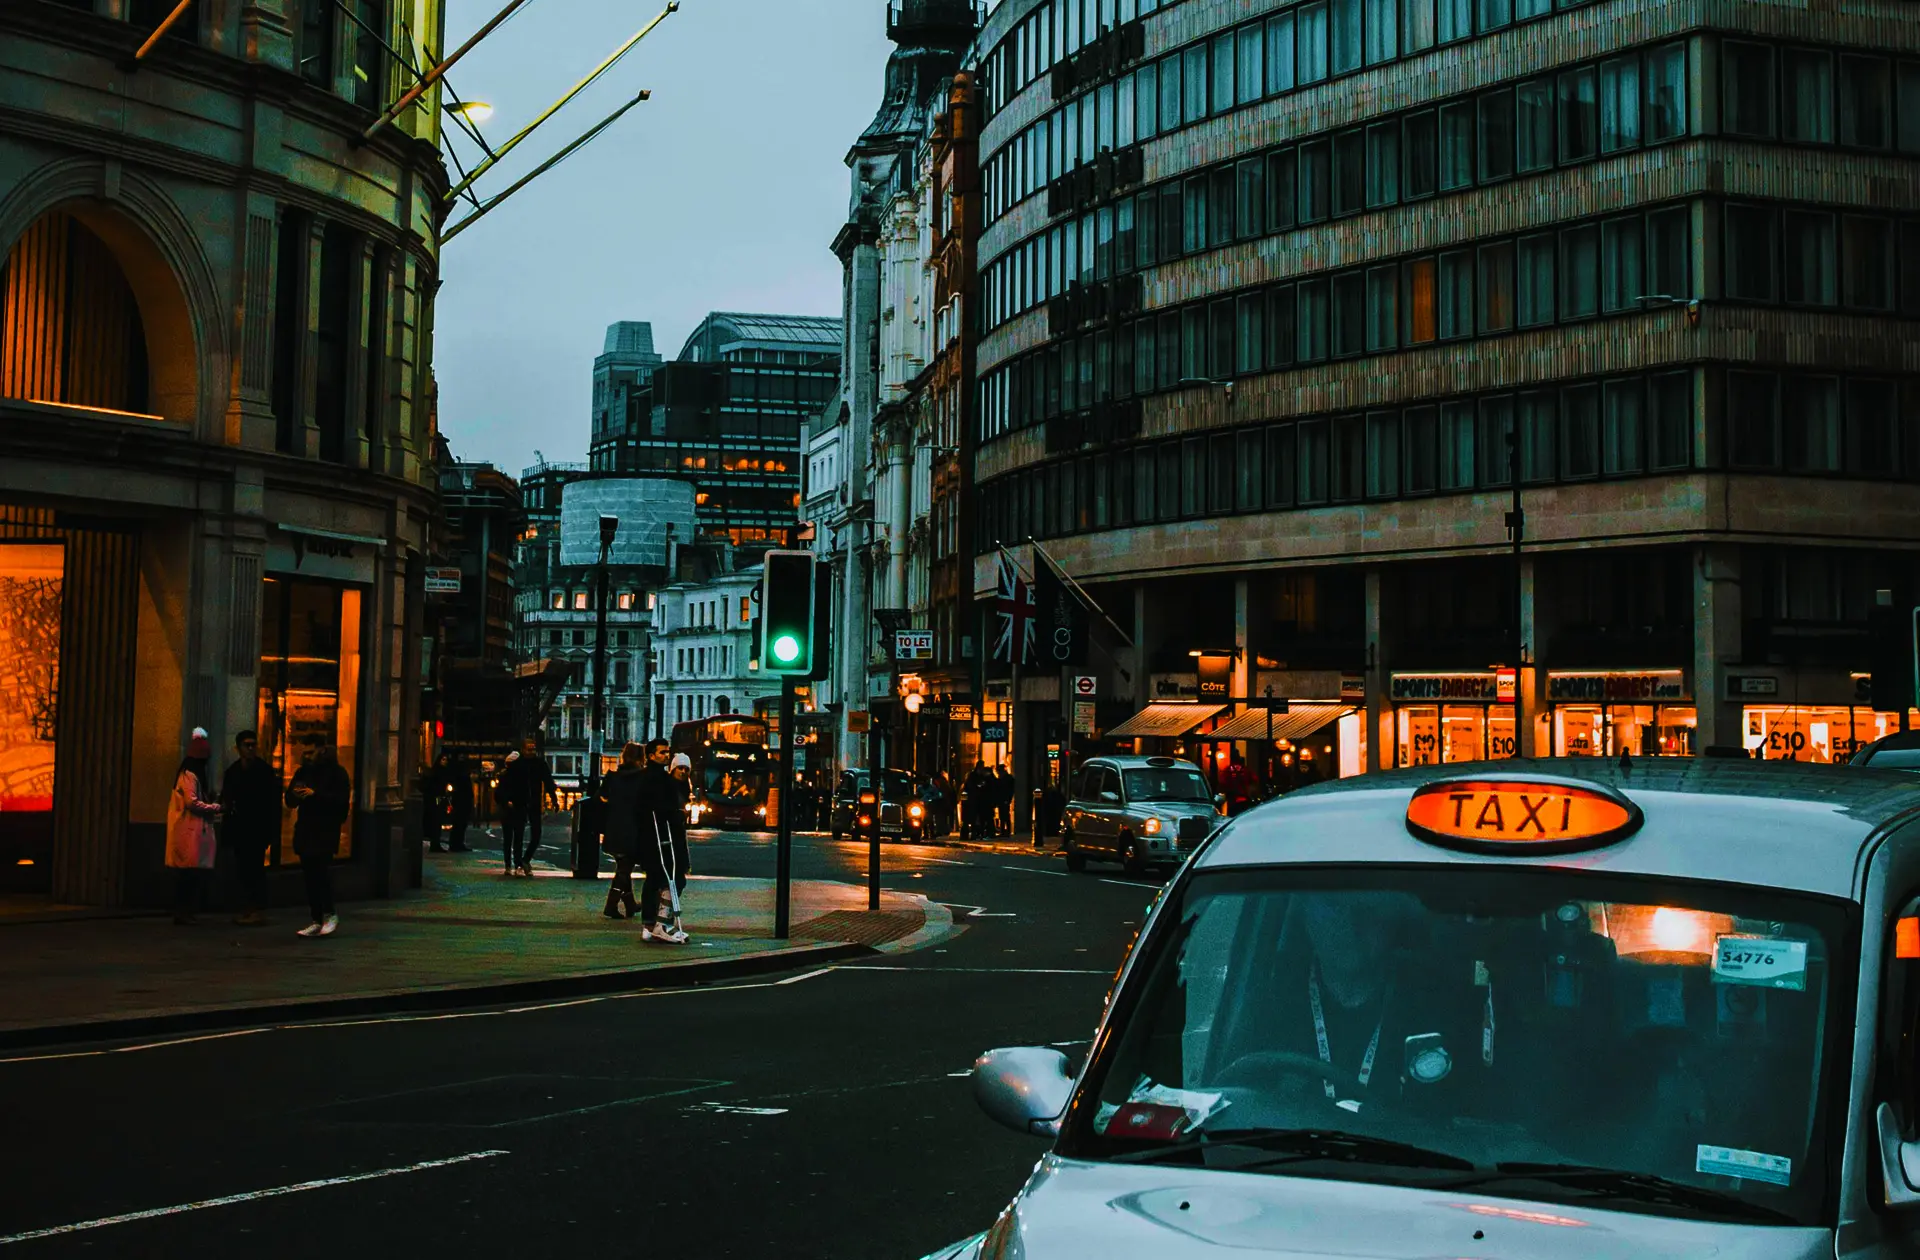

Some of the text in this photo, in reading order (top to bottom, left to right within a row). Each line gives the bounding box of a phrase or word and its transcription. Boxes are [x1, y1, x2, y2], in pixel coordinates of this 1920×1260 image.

[899, 637, 930, 647] TO LET
[1201, 681, 1226, 692] CÔTE
[922, 707, 945, 715] RUSH
[1493, 737, 1515, 754] £10
[1771, 731, 1805, 750] £10
[748, 753, 757, 761] 4
[1450, 794, 1571, 833] TAXI
[1721, 951, 1774, 965] 54776
